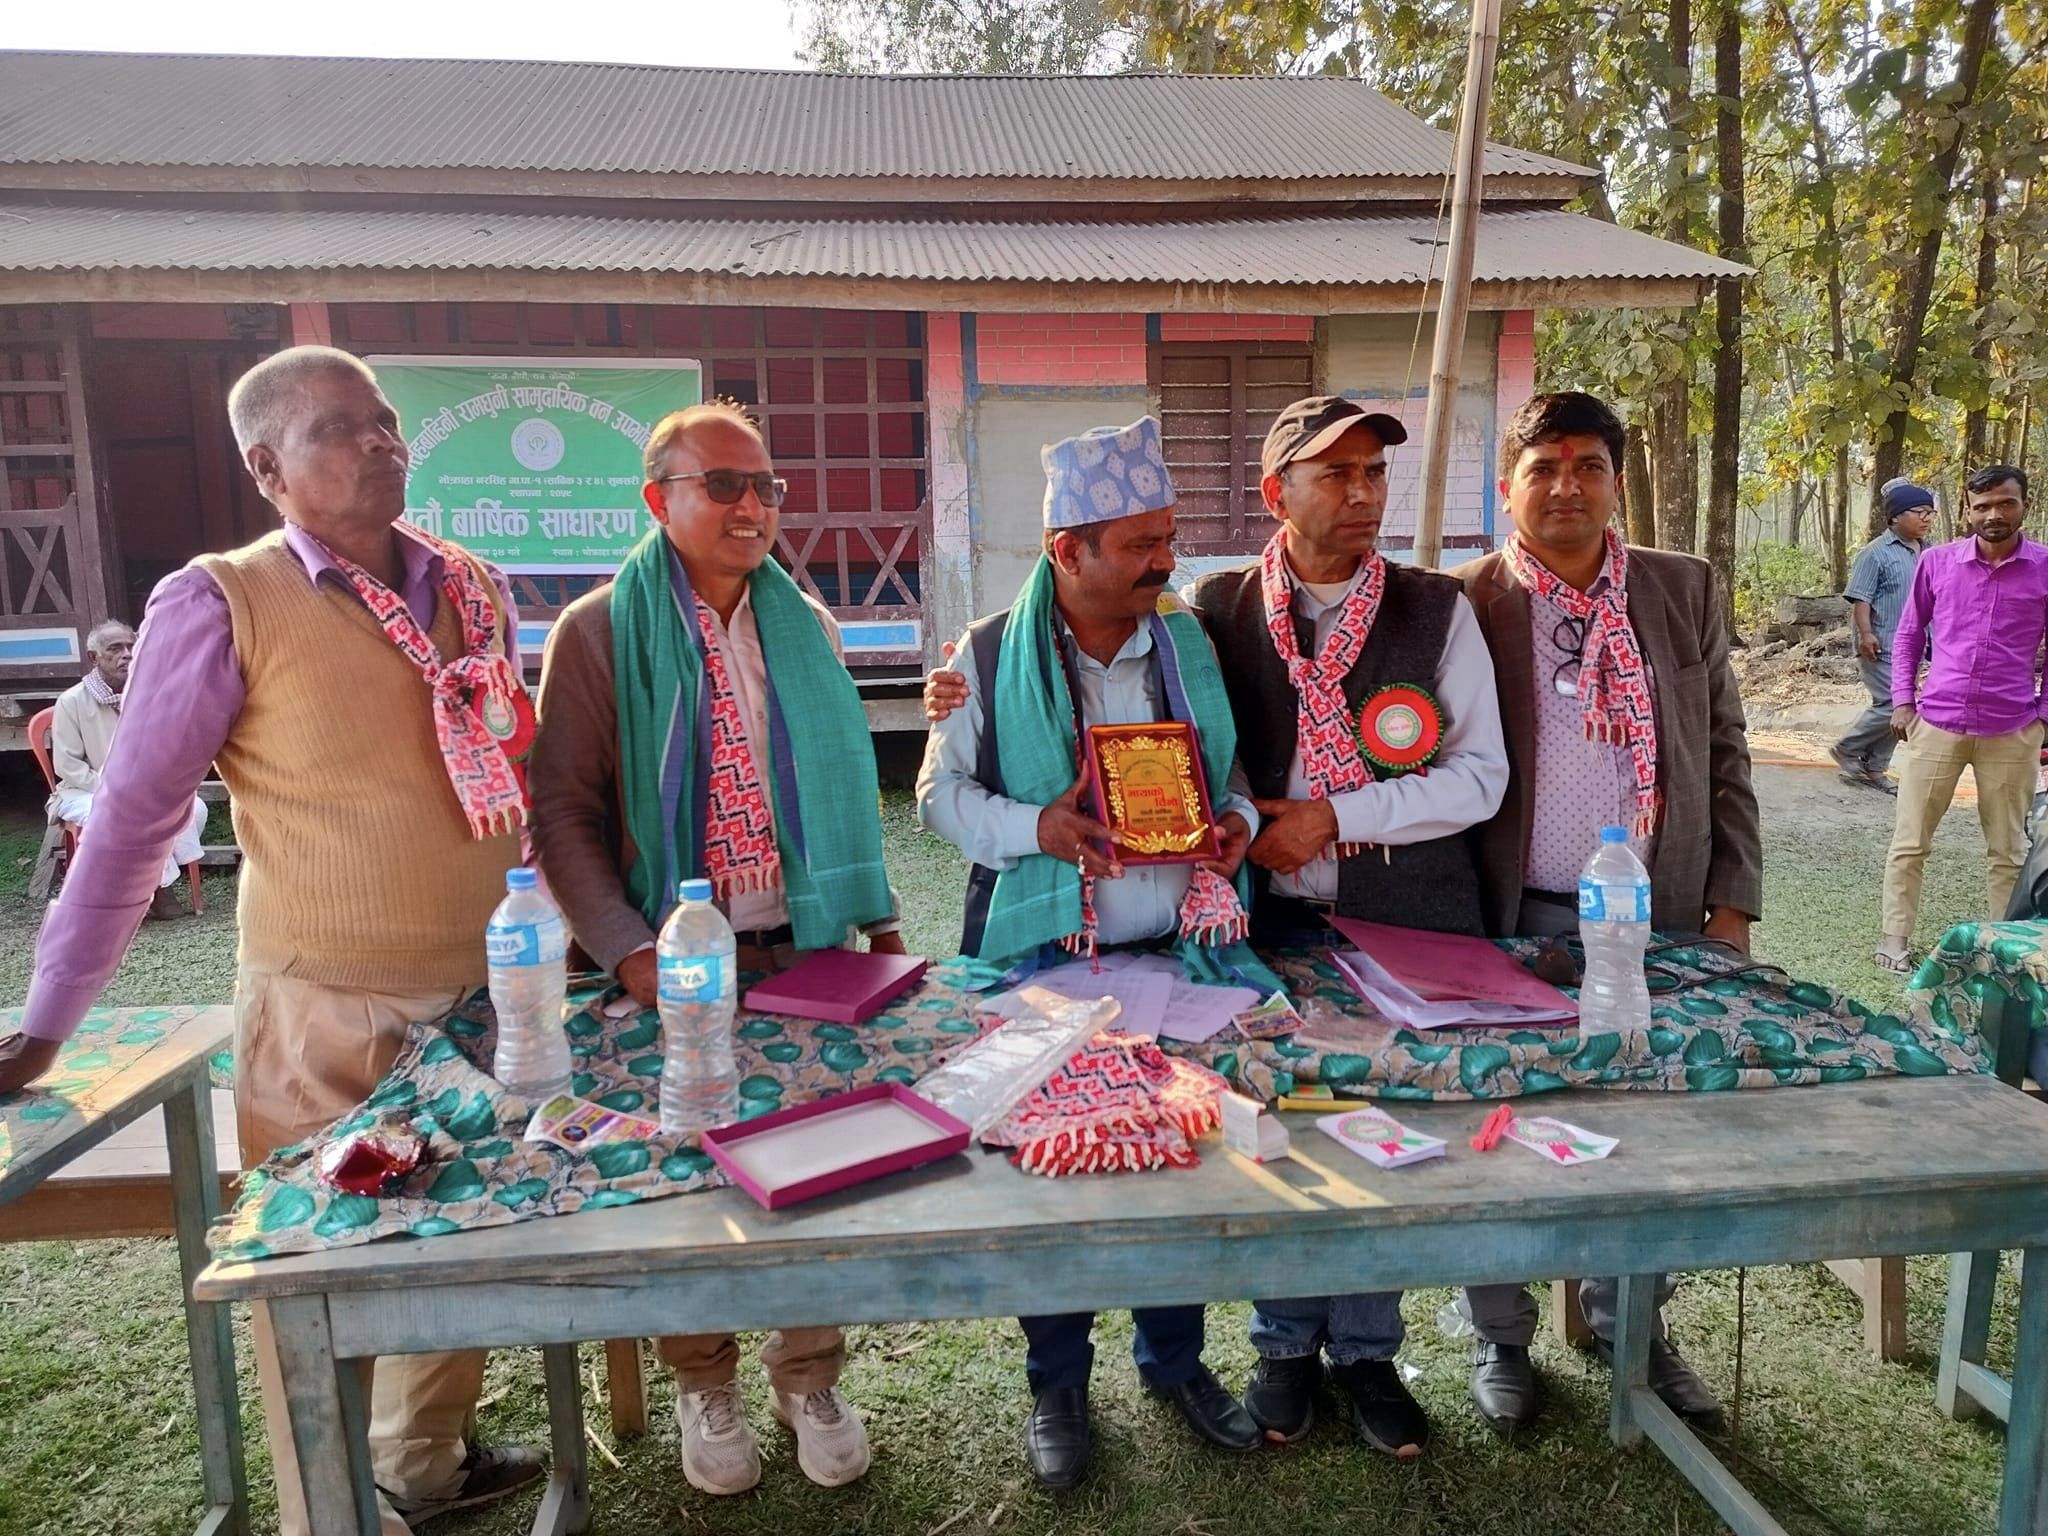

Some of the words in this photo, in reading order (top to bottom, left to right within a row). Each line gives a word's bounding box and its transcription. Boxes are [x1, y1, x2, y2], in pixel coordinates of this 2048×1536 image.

[511, 382, 589, 413] सामुदायिक
[589, 398, 614, 424] वन
[537, 507, 638, 540] साधारण
